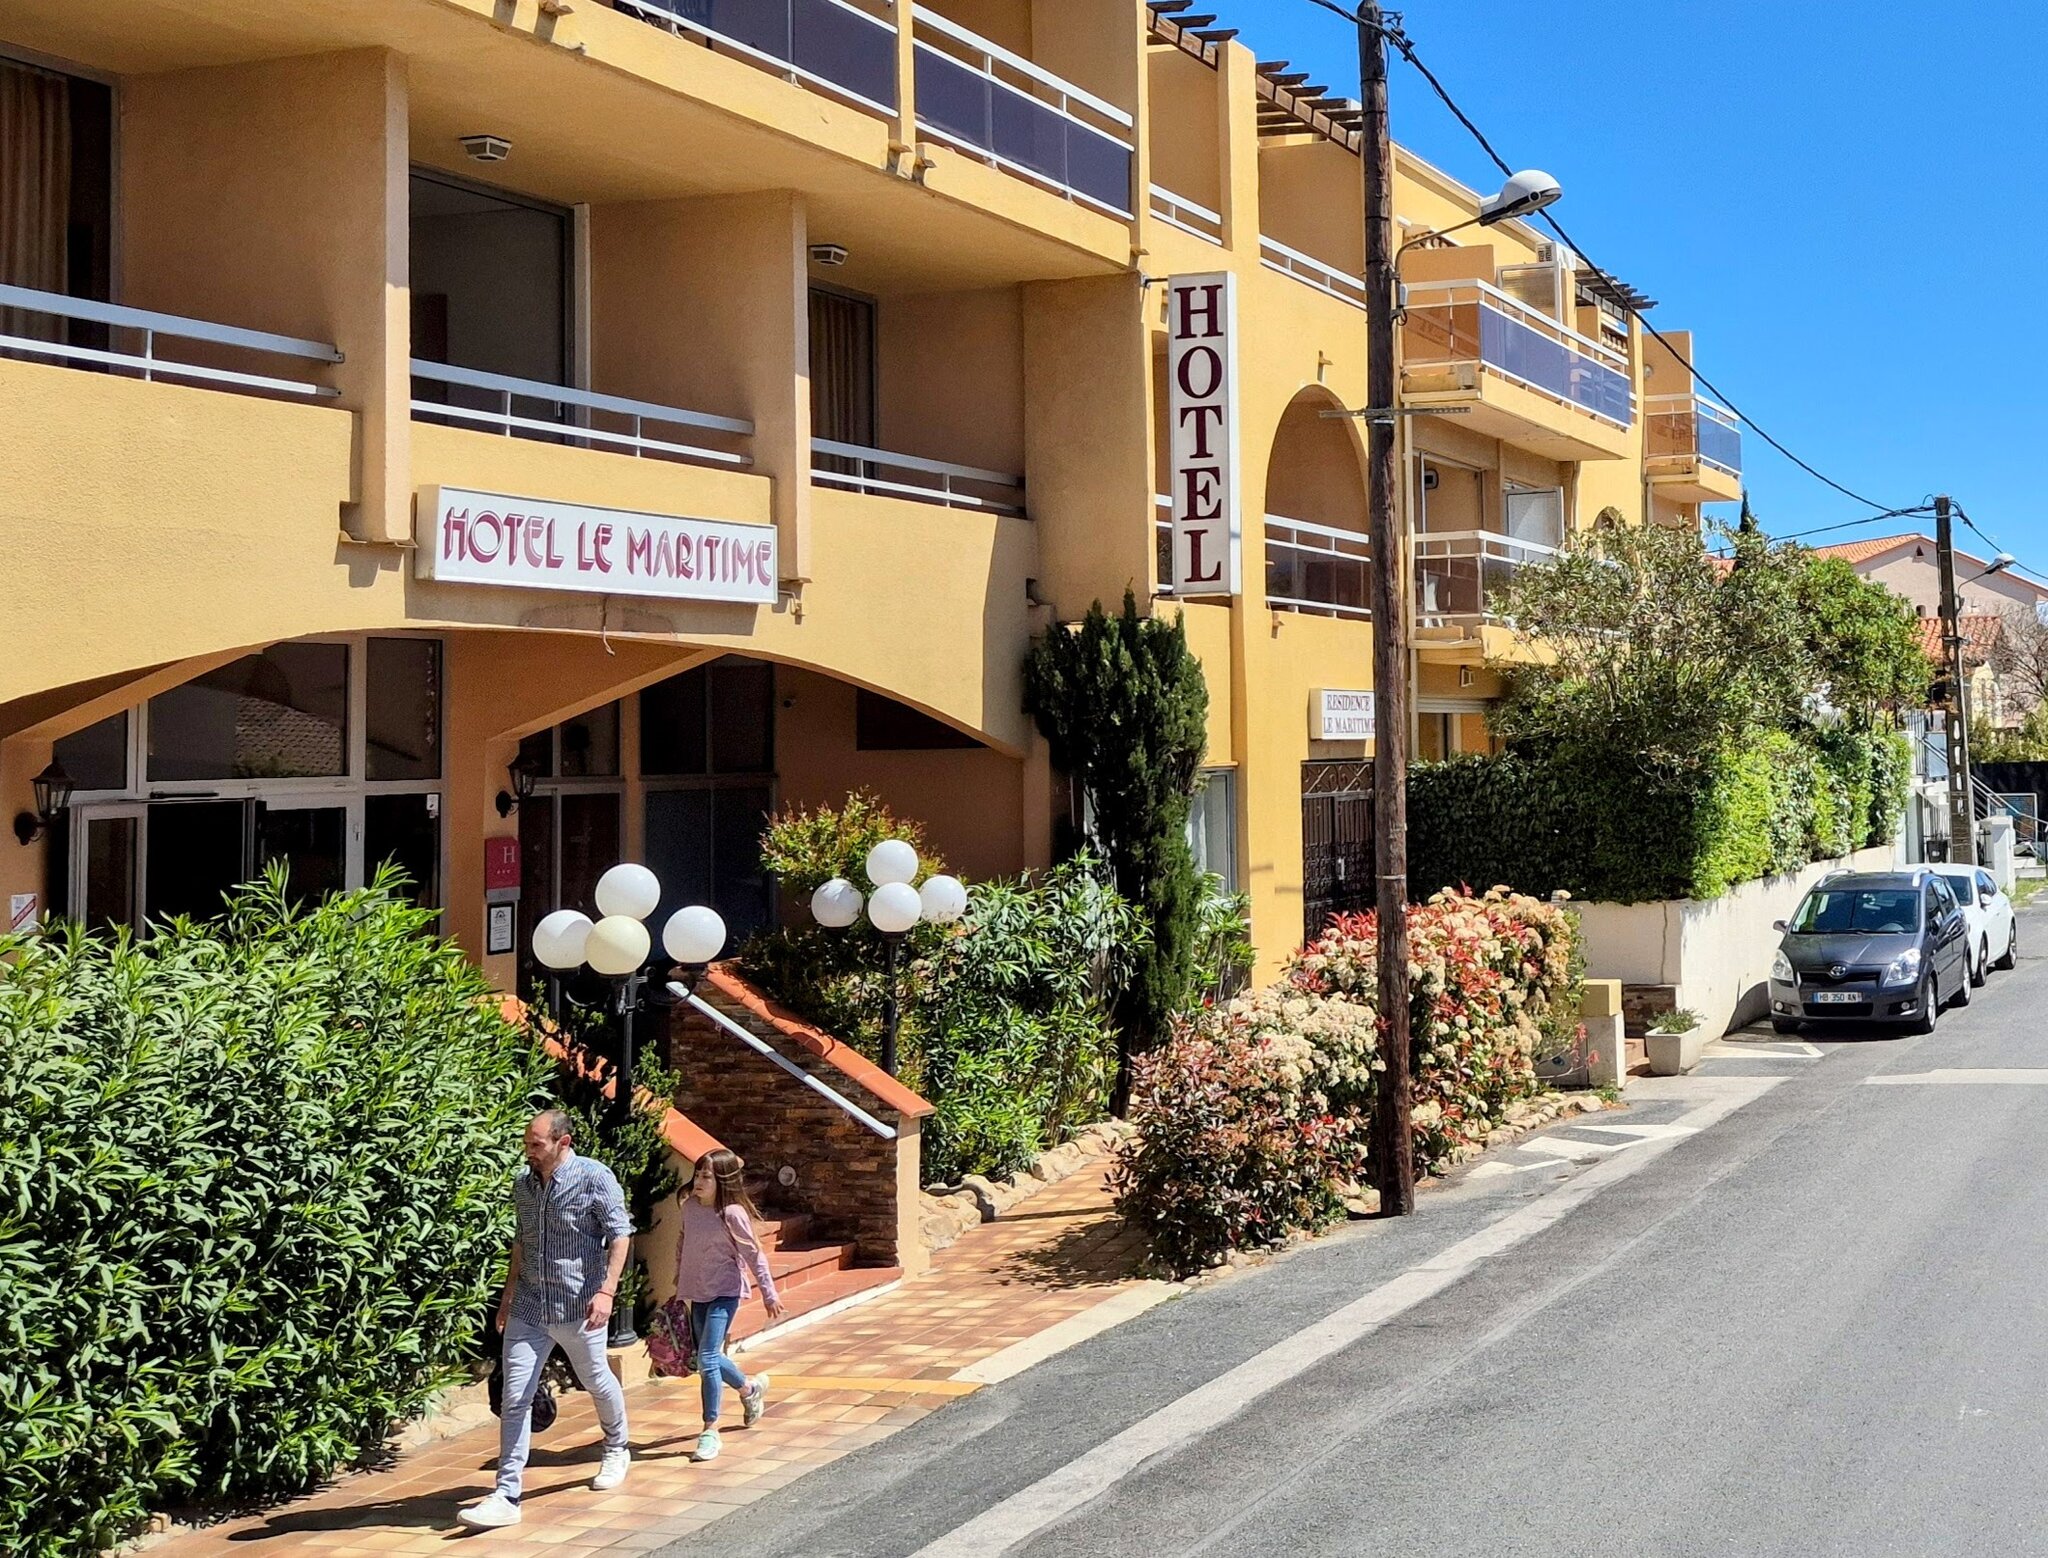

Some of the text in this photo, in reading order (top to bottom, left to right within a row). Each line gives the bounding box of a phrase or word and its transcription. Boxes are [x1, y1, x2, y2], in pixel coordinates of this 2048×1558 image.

[1174, 284, 1224, 583] HOTEL
[443, 506, 772, 587] HOTEL LE MARITIME
[1327, 694, 1370, 711] RESIDENCE
[1324, 717, 1333, 733] LE
[503, 846, 515, 864] H
